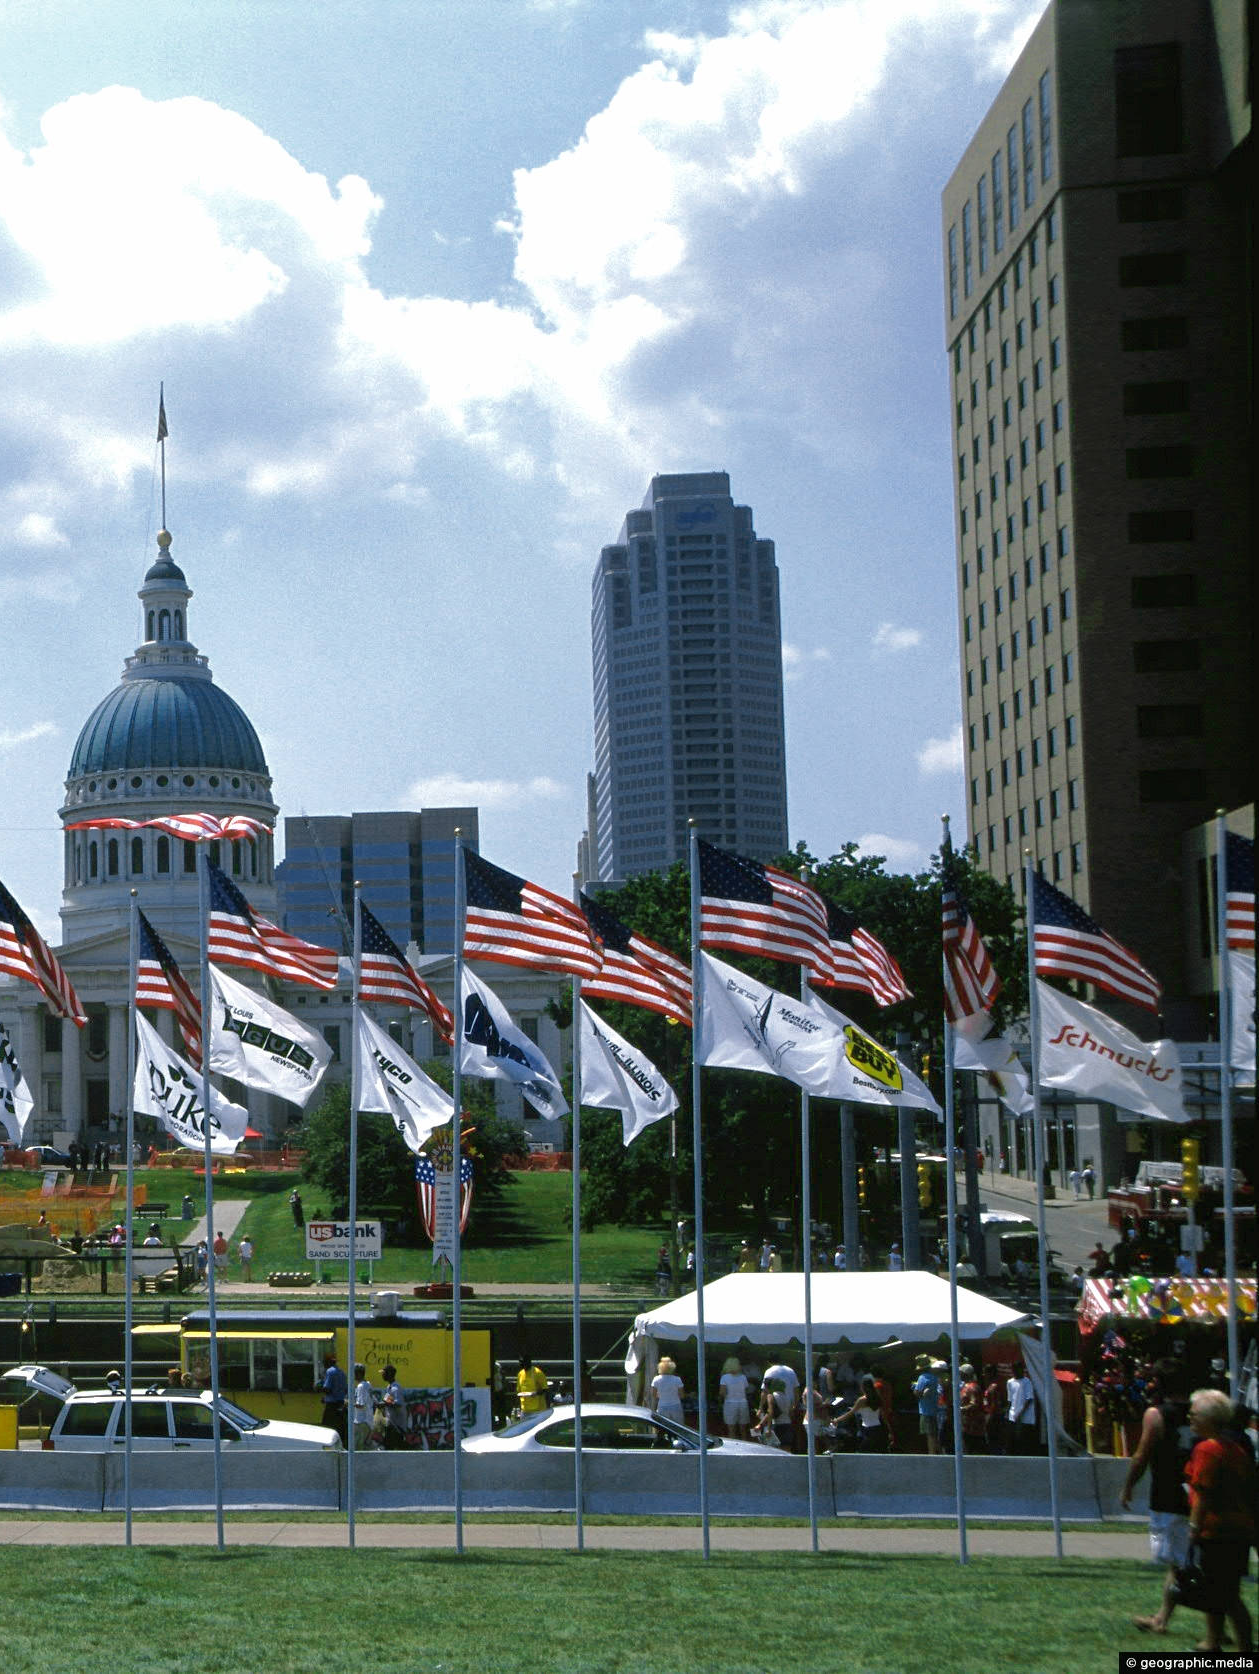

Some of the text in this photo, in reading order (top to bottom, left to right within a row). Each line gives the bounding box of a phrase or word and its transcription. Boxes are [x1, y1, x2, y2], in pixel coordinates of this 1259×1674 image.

[233, 1007, 254, 1020] LOUIS
[778, 1008, 822, 1032] Monitor
[851, 1044, 897, 1081] BUY
[1049, 1025, 1175, 1082] Schnucks
[270, 1055, 312, 1081] NEWSPAPER
[624, 1057, 662, 1102] ILLINOIS
[150, 1060, 222, 1140] Duke
[308, 1250, 331, 1258] SAND
[362, 1338, 414, 1351] Funnel
[364, 1351, 409, 1366] Cakes
